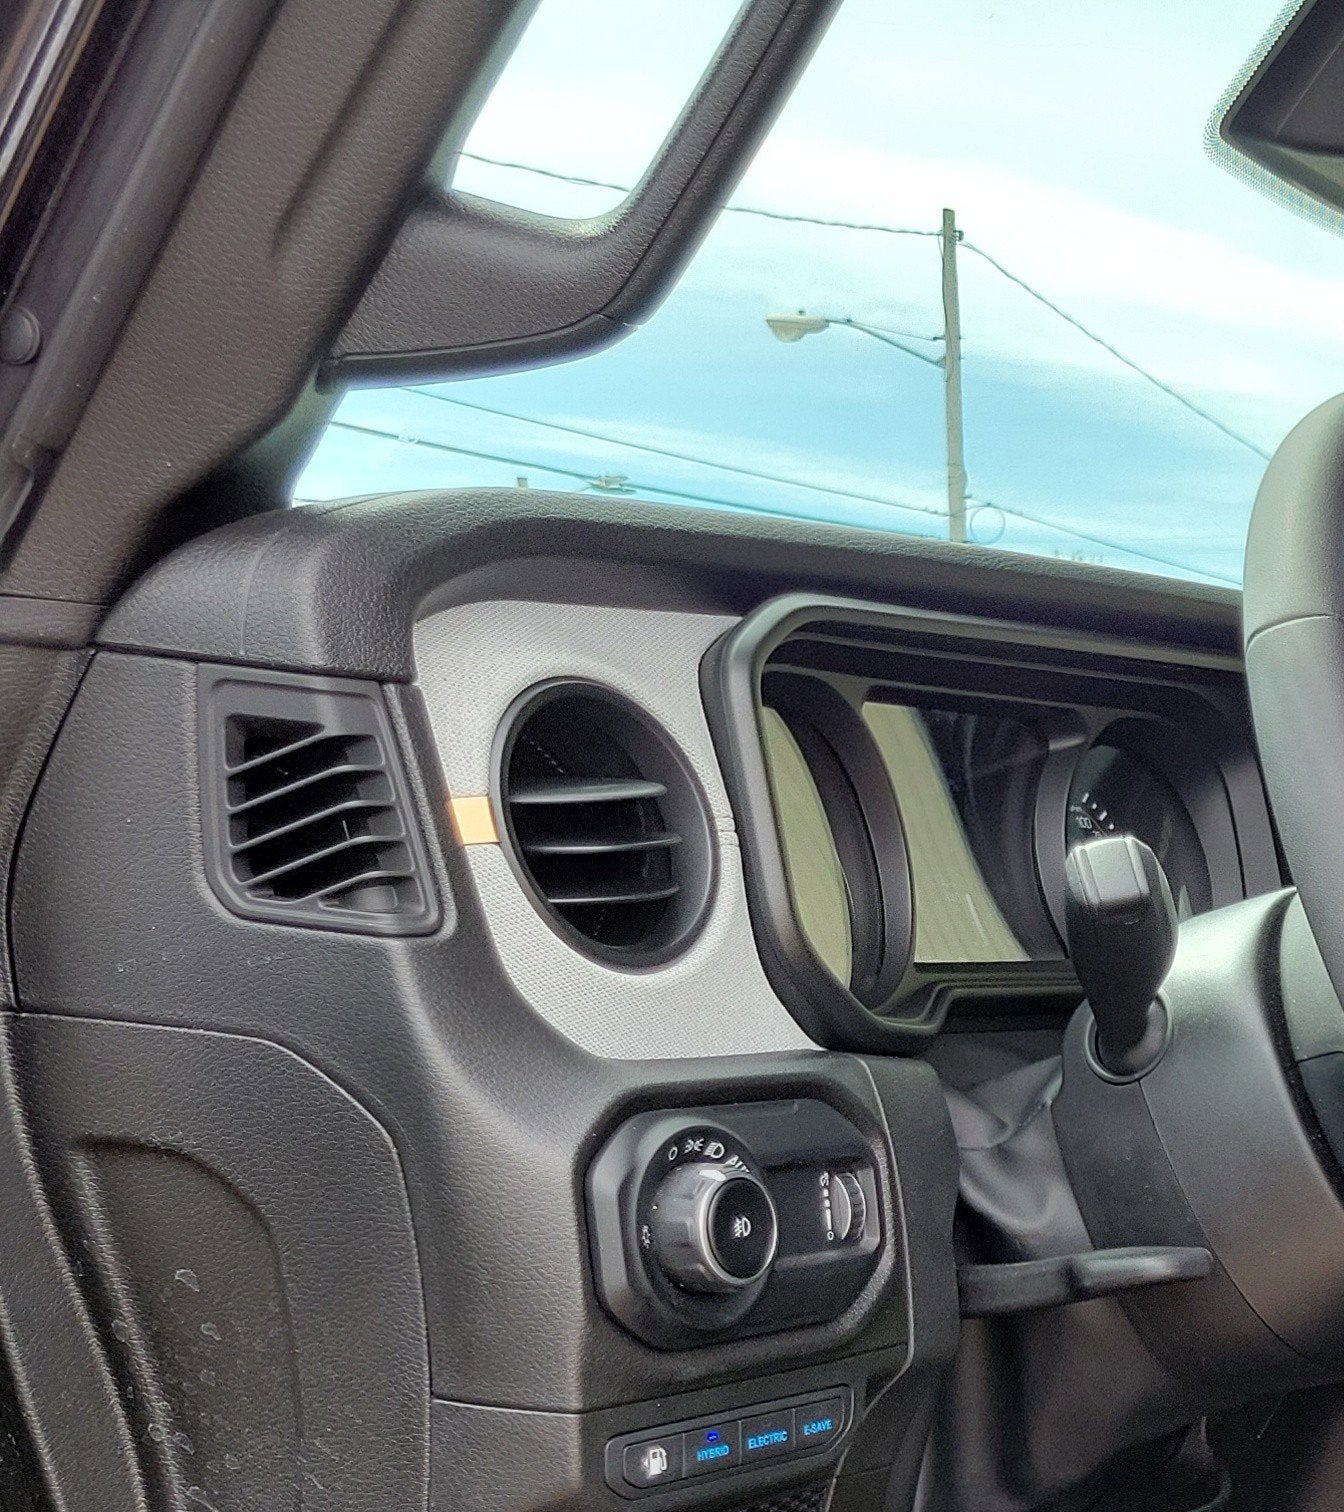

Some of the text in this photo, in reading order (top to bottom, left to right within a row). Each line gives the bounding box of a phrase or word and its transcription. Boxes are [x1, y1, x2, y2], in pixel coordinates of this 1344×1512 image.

[803, 1418, 833, 1436] E-SAVE
[747, 1430, 788, 1449] ELECTRIC
[697, 1444, 730, 1461] HYBRID
